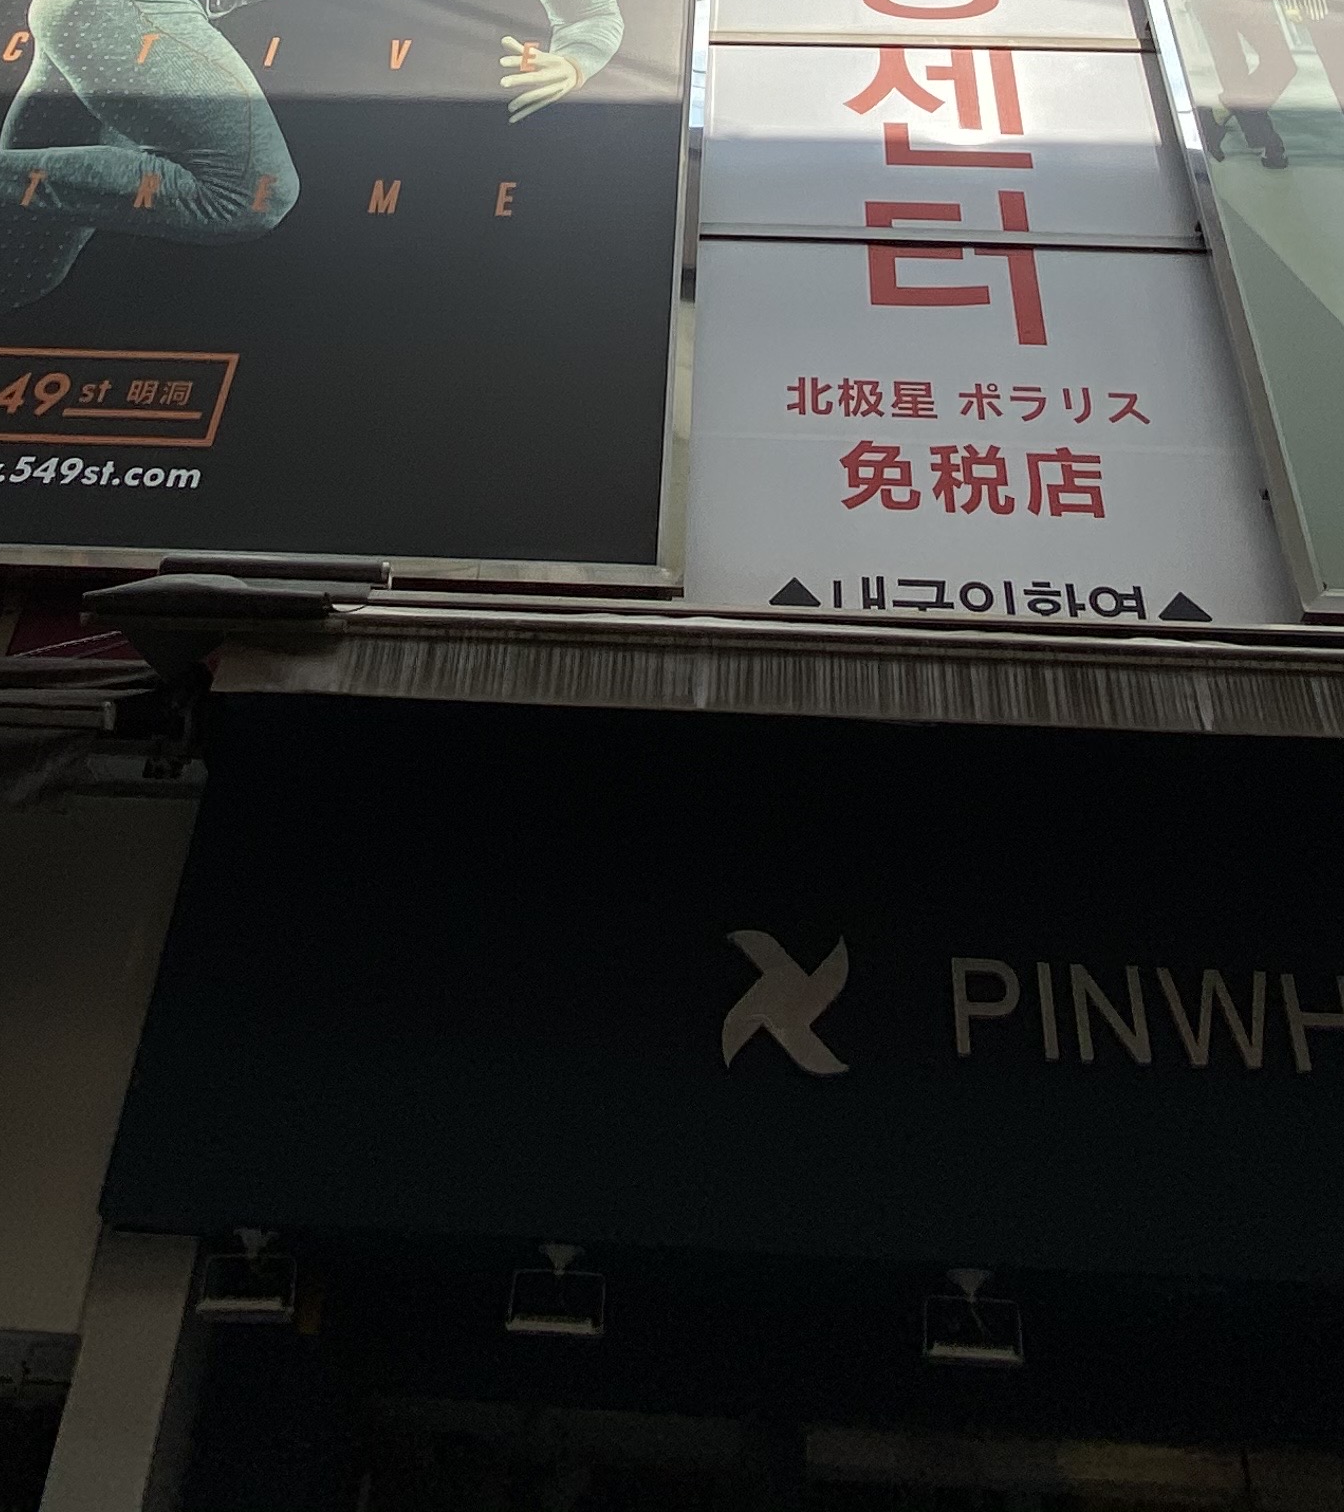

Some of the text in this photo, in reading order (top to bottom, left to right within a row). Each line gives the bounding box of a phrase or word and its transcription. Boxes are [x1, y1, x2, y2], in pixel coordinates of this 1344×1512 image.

[78, 377, 113, 405] st
[126, 378, 192, 408] 明洞
[786, 377, 1152, 426] 北极星 ポラリス
[838, 440, 1107, 520] 免税店
